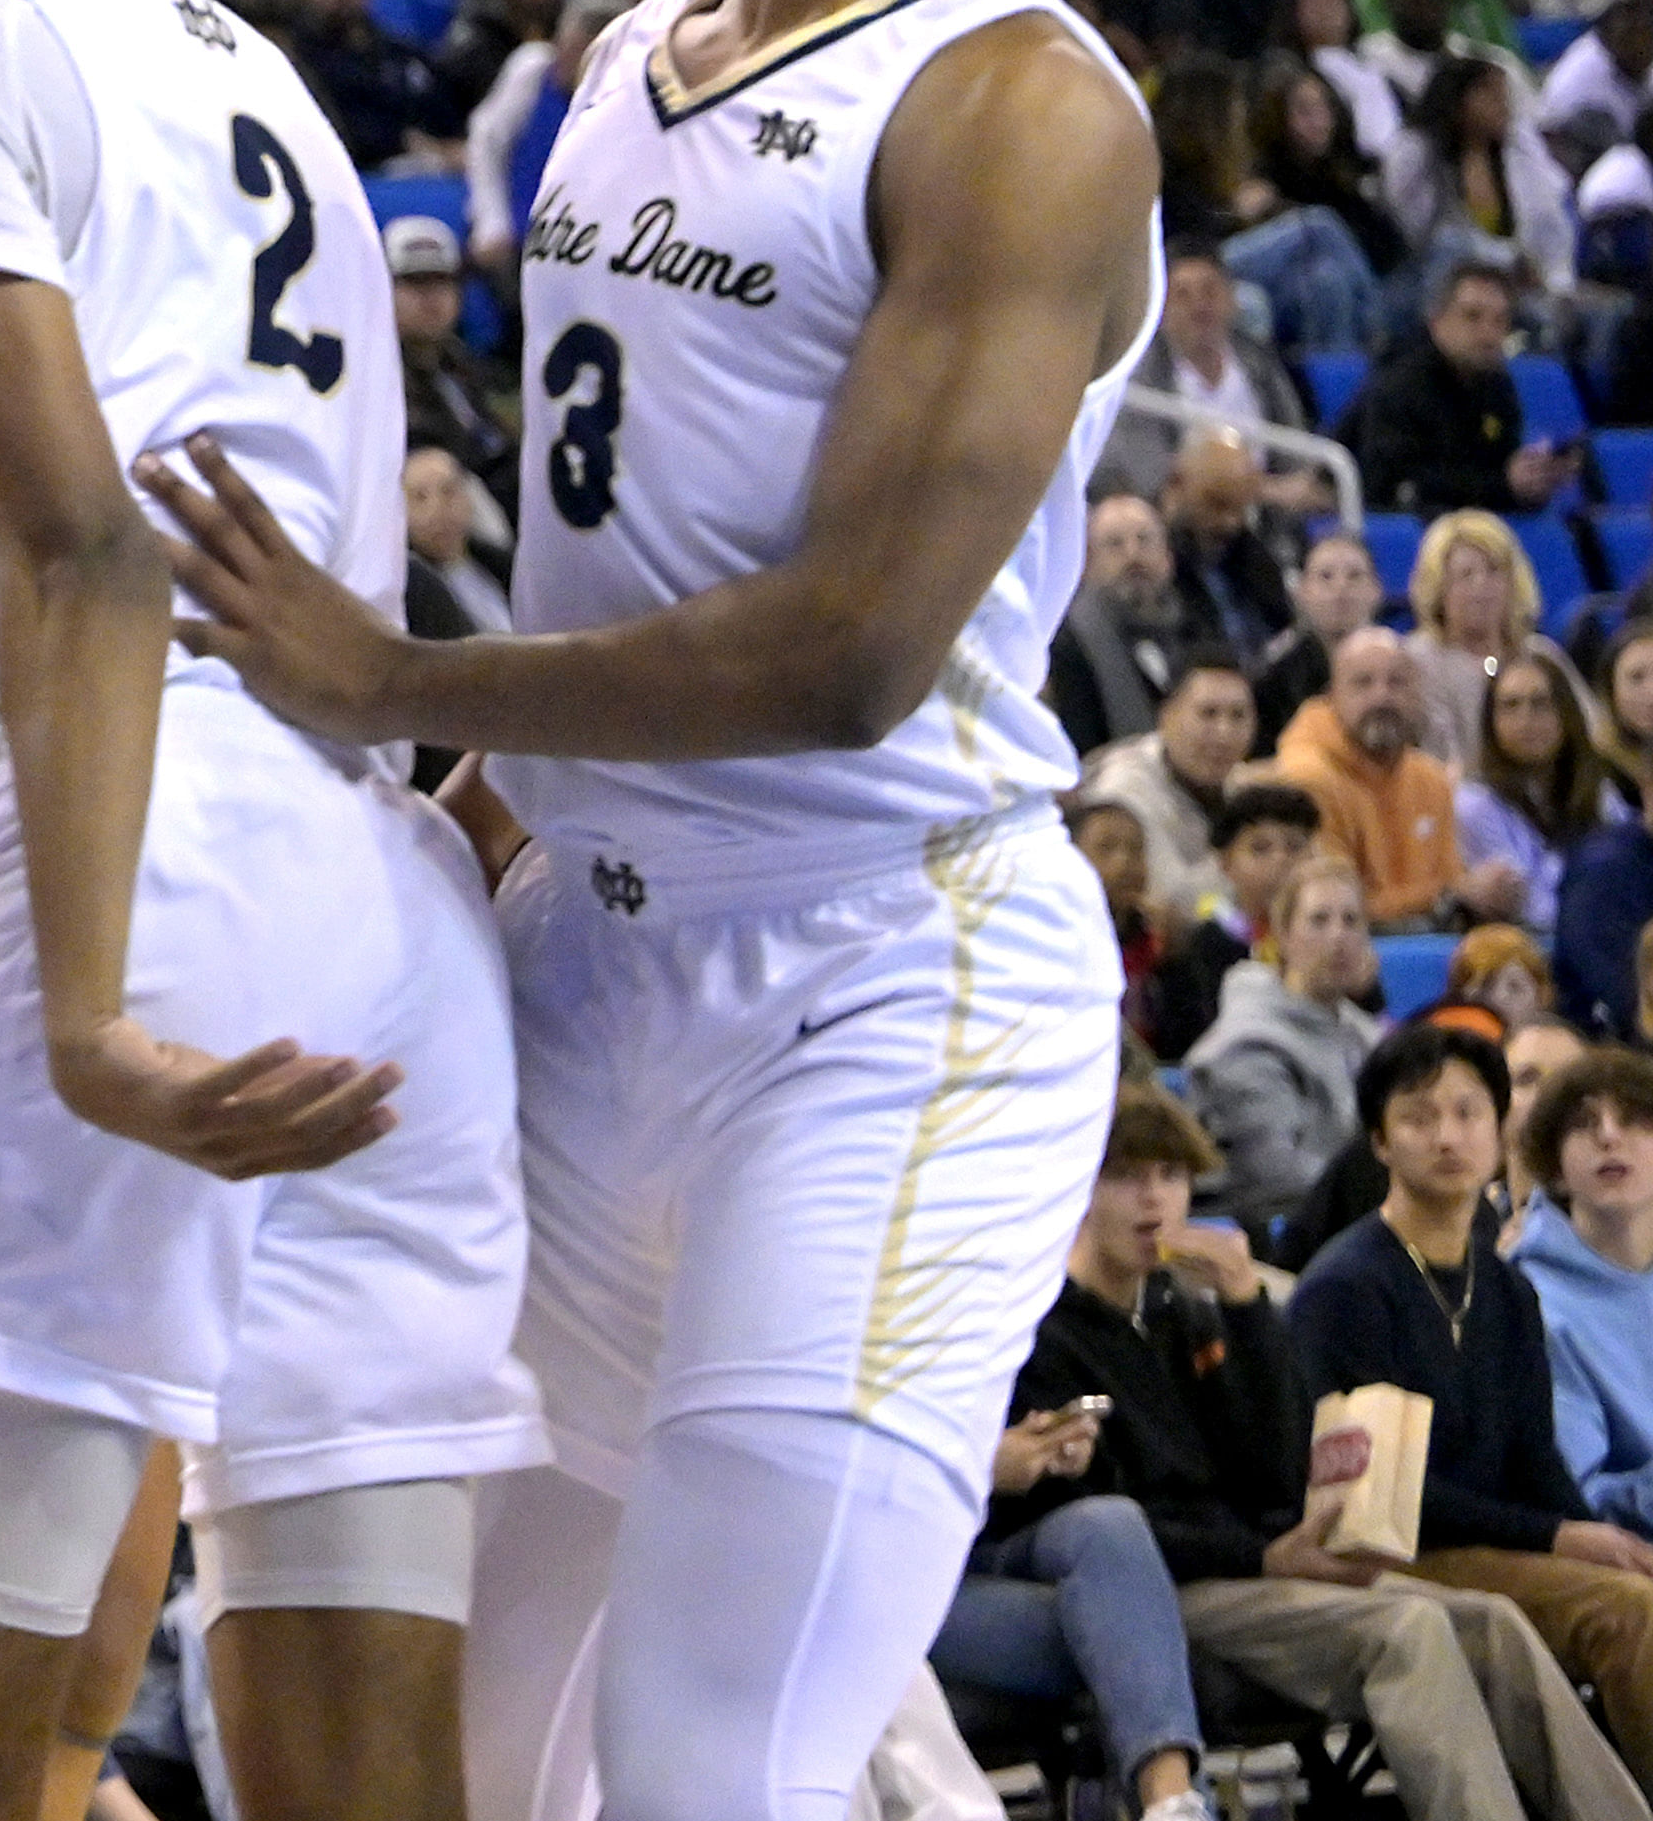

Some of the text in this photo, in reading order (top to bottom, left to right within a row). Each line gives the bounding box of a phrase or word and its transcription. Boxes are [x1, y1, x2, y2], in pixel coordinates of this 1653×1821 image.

[230, 110, 345, 400] 2
[610, 197, 777, 308] Dame
[544, 320, 622, 529] 3
